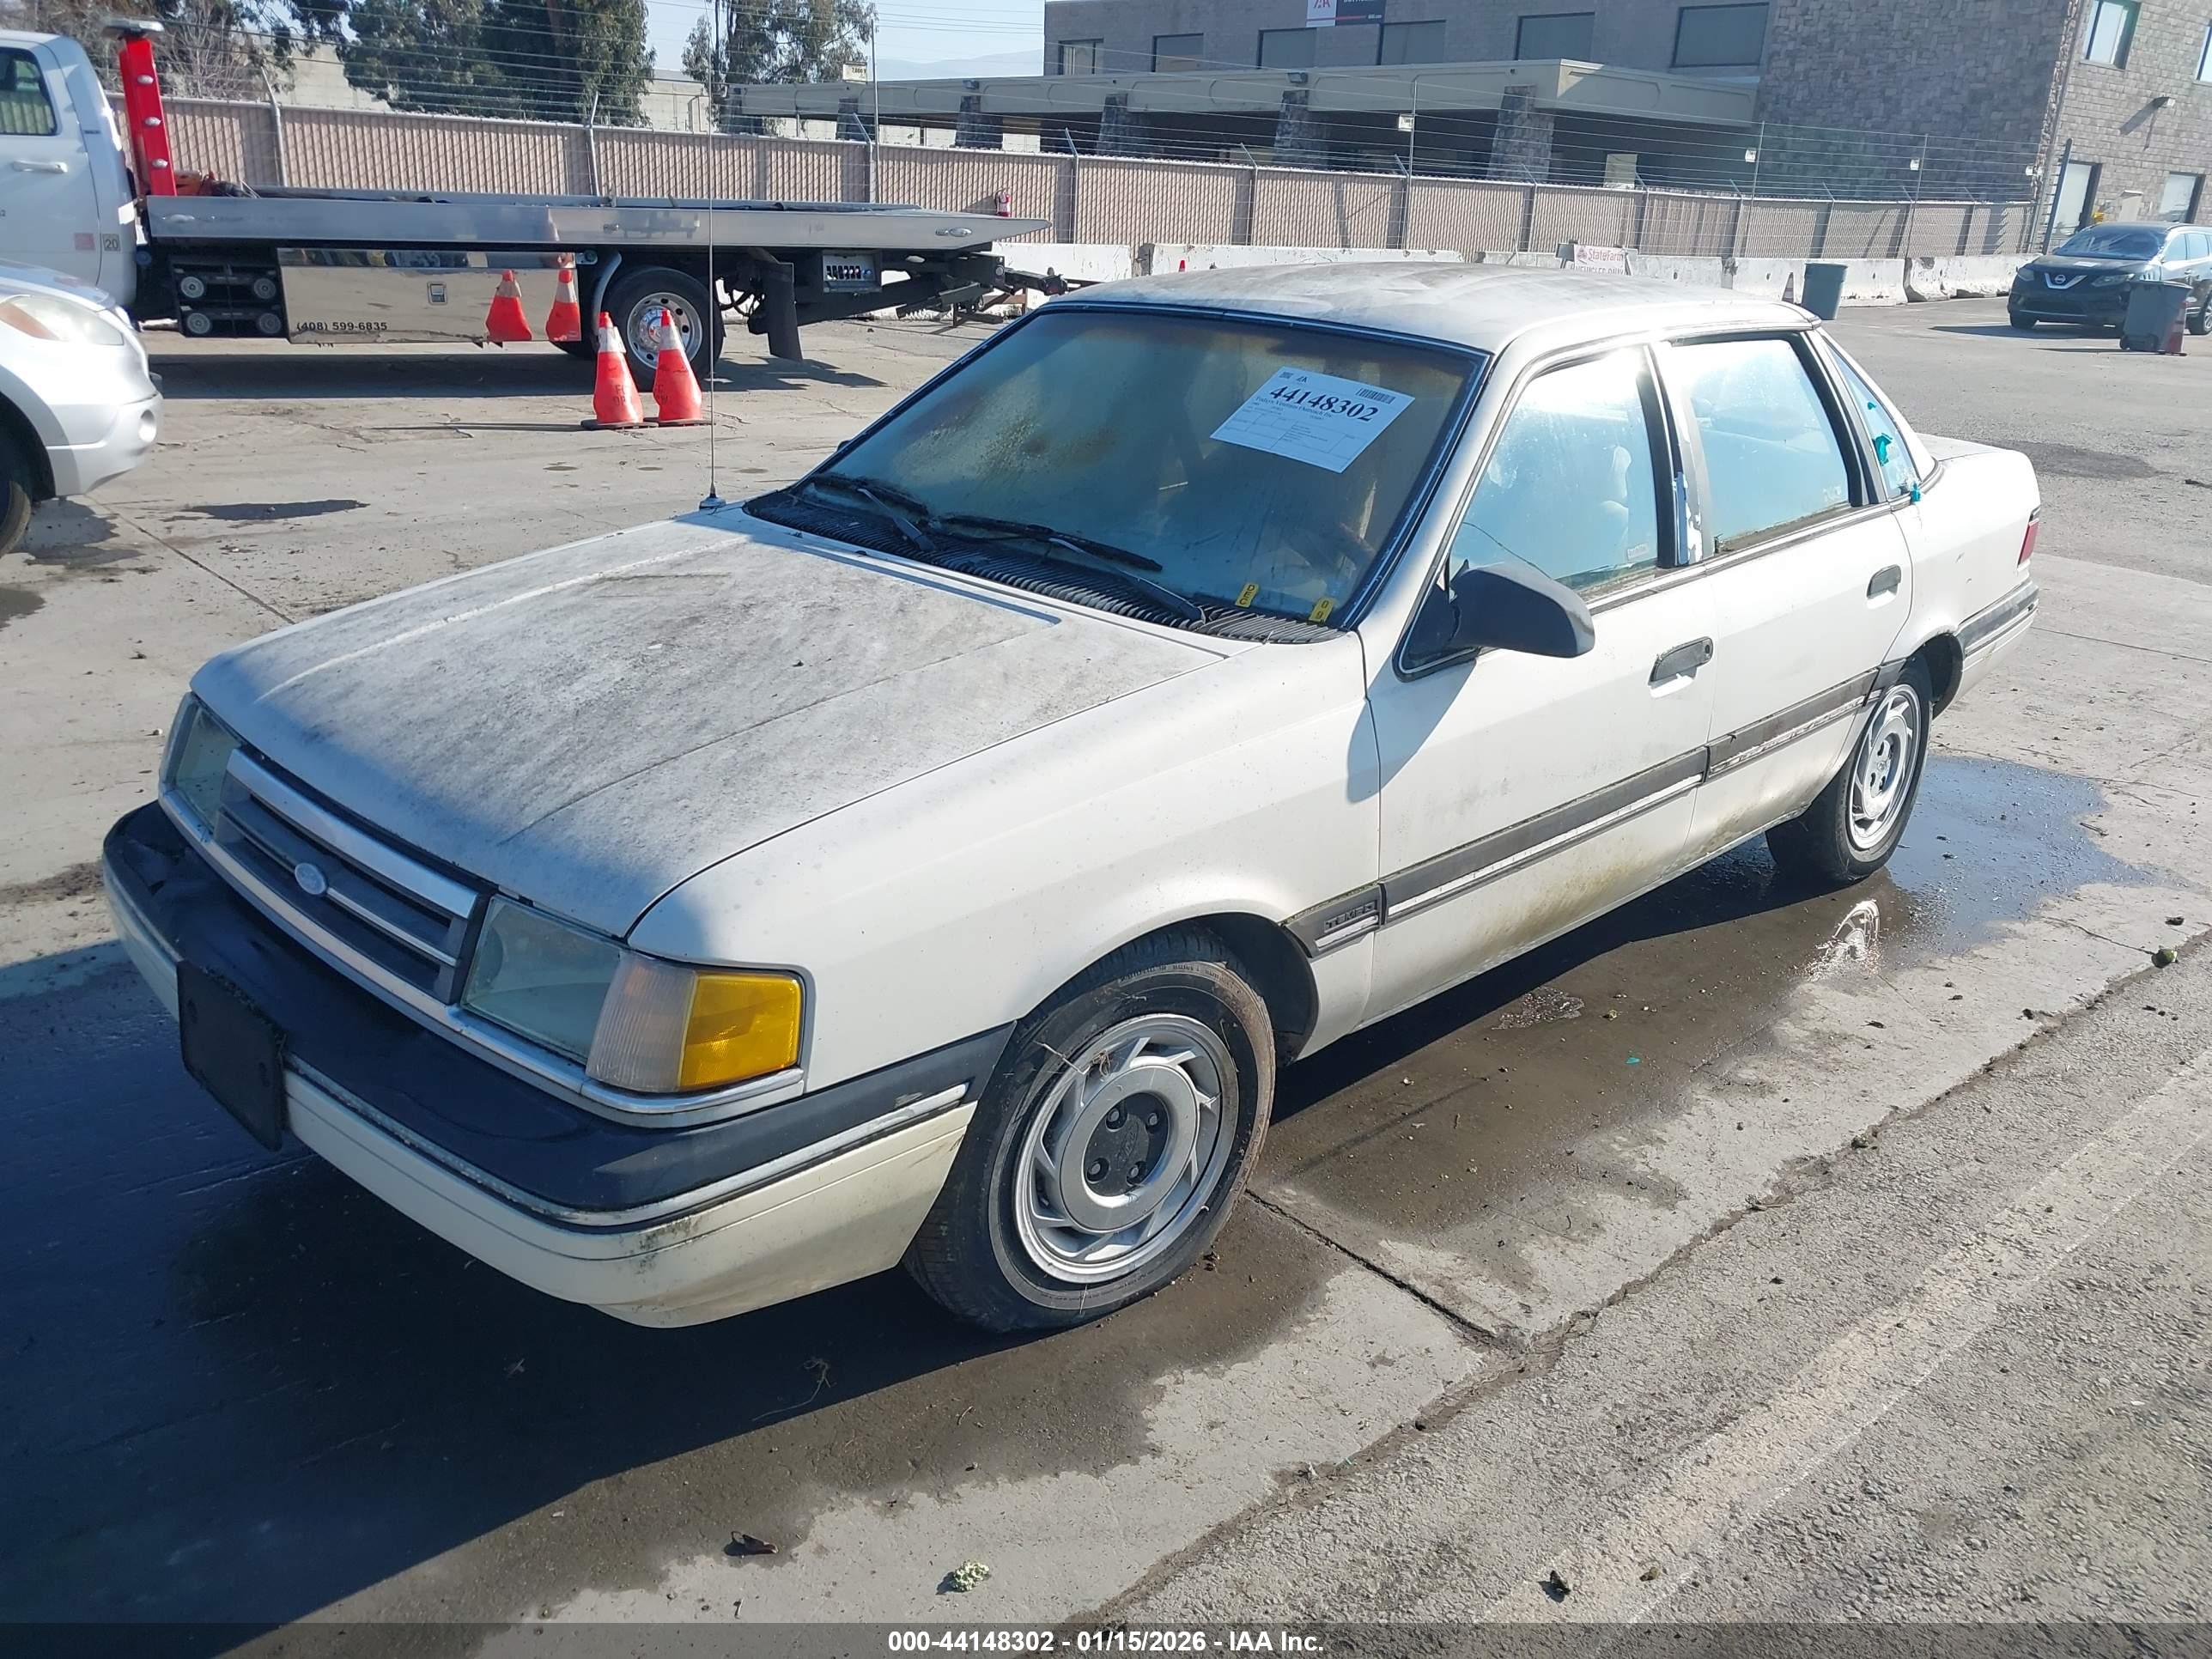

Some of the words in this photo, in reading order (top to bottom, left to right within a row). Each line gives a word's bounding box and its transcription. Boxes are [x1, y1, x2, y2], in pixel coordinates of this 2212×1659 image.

[296, 321, 328, 331] (408)
[332, 322, 388, 331] 599-6835
[1269, 386, 1379, 422] 44148302
